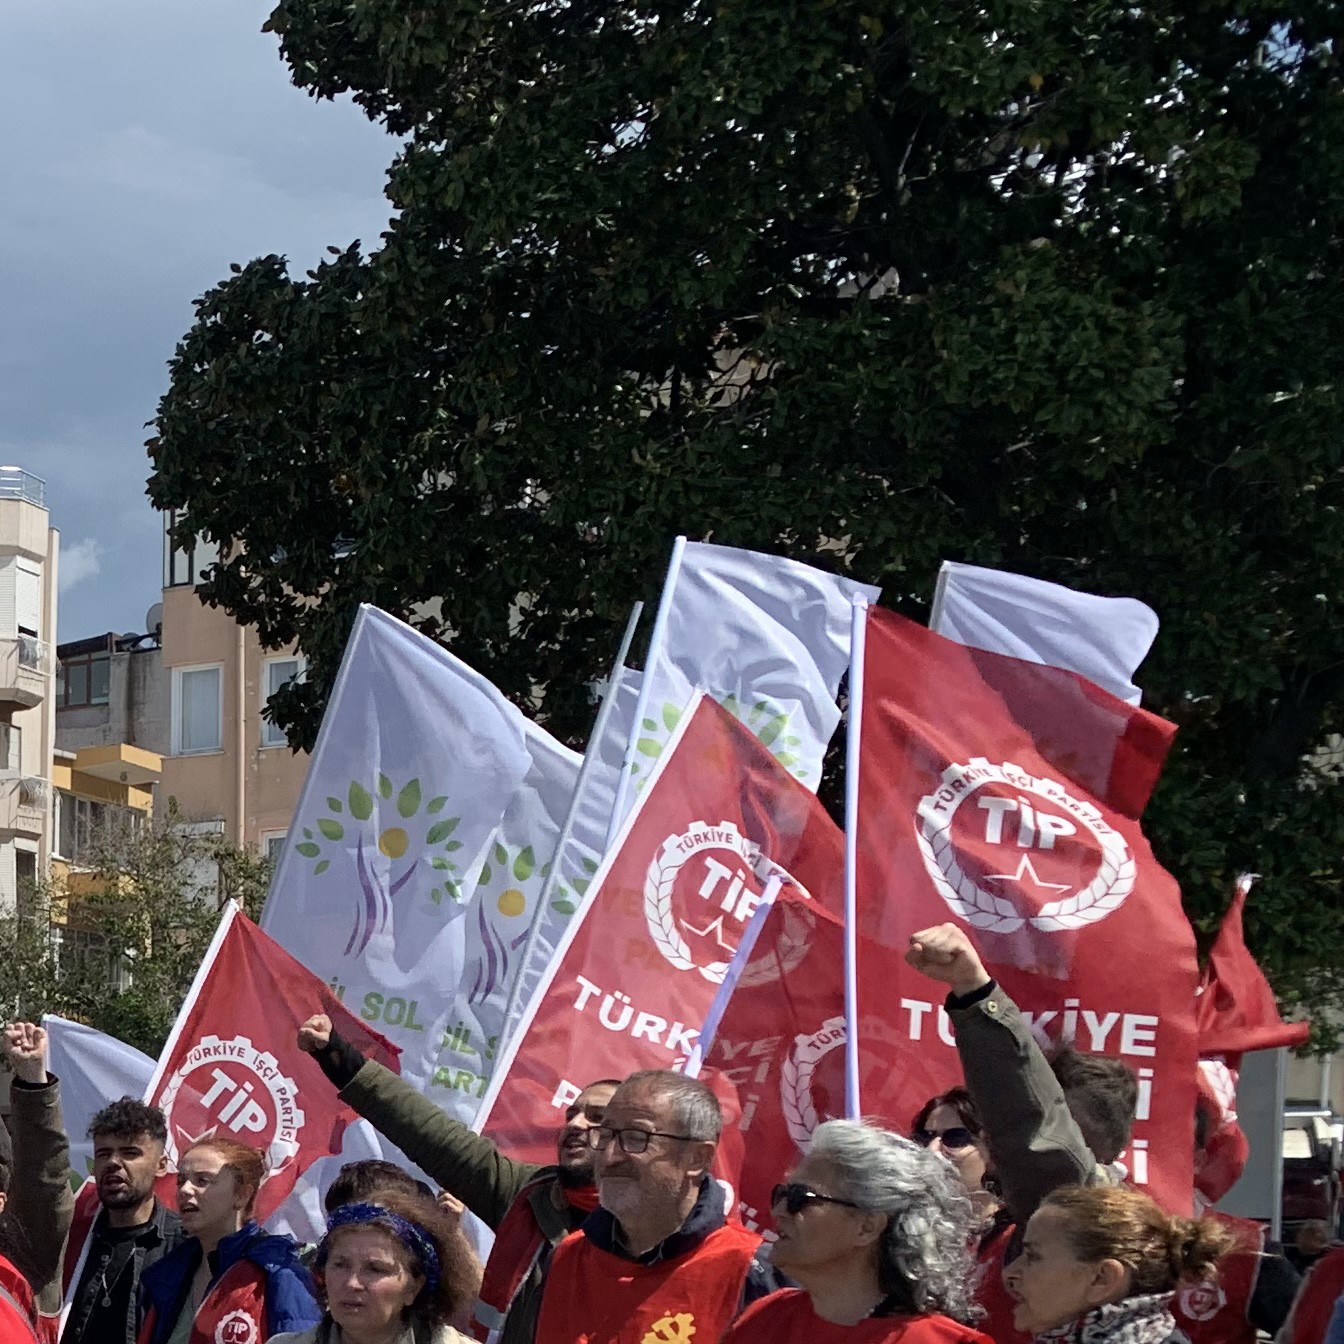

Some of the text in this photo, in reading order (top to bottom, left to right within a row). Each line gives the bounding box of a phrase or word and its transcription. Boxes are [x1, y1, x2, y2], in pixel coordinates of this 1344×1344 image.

[932, 766, 992, 812] TÜRKİYE
[1047, 788, 1113, 835] PARTİSİ
[977, 795, 1077, 849] TİP
[675, 830, 735, 854] TÜRKİYE
[360, 991, 424, 1032] SOL
[189, 1042, 297, 1144] TÜRKİYE İŞÇİ PARTİSİ
[200, 1067, 268, 1134] TİP
